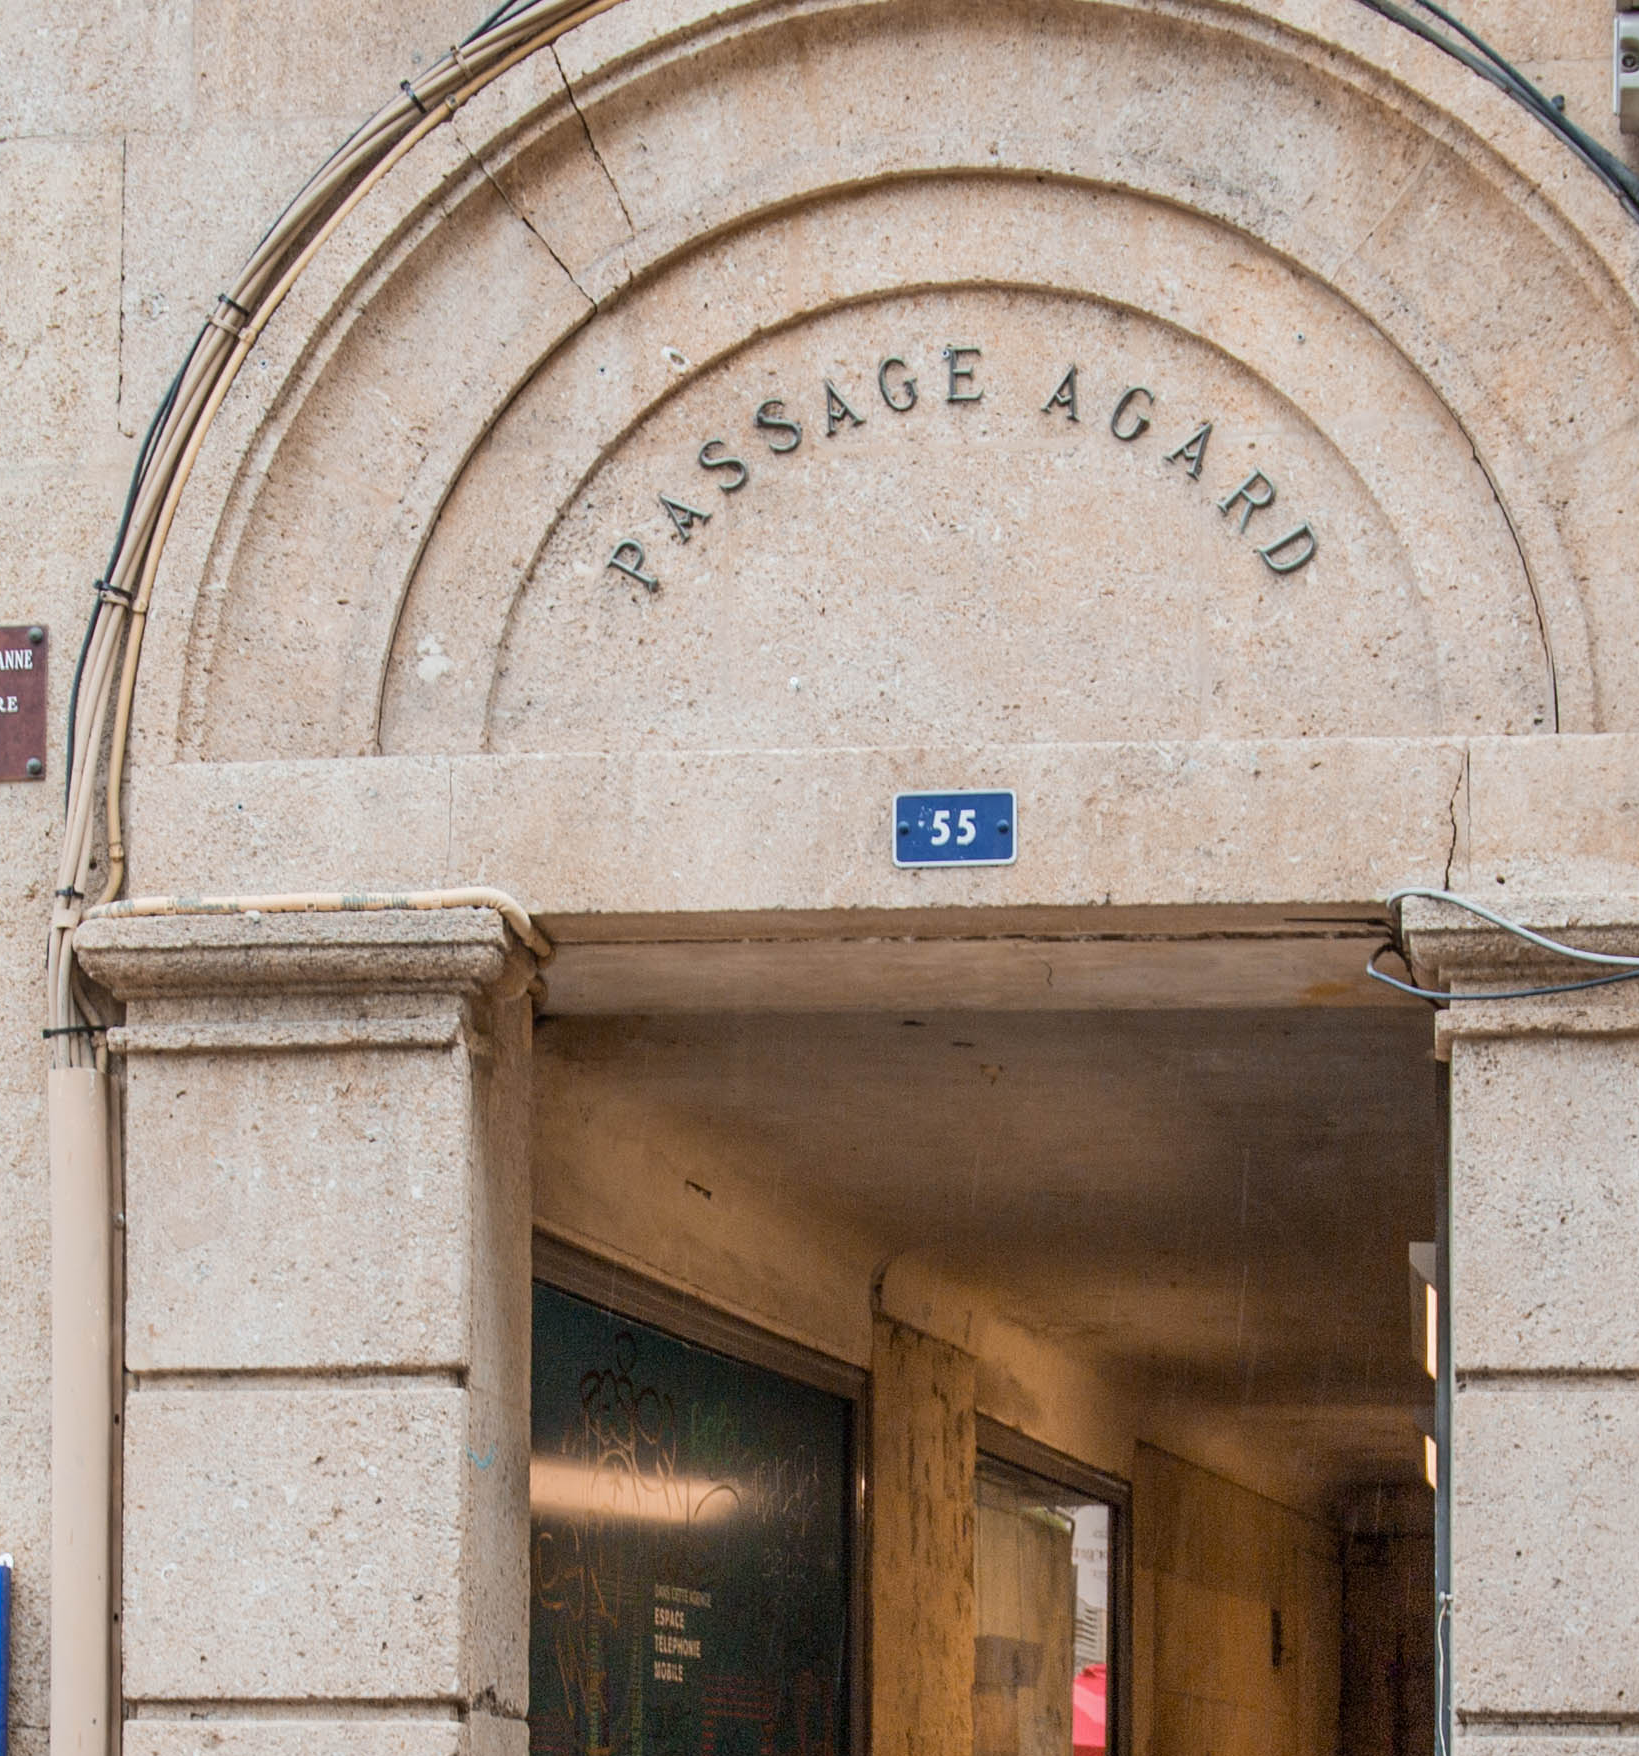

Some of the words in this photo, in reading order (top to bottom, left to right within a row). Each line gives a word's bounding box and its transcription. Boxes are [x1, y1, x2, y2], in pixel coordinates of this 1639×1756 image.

[607, 346, 984, 593] PASSAGE
[1040, 364, 1318, 575] AGARD
[930, 808, 978, 848] 55
[654, 1607, 685, 1630] ESPACE
[654, 1660, 683, 1683] MOBILE
